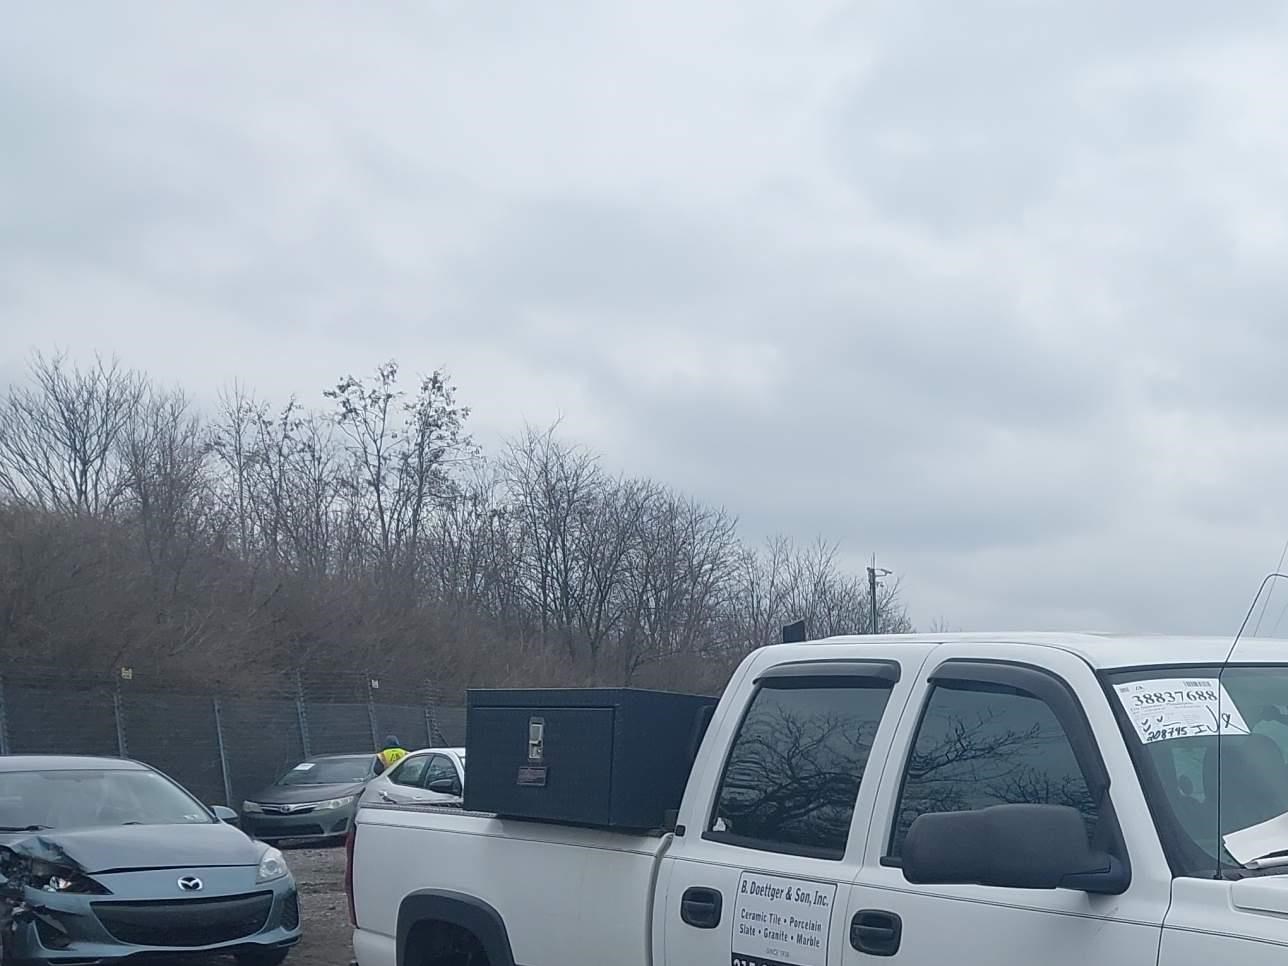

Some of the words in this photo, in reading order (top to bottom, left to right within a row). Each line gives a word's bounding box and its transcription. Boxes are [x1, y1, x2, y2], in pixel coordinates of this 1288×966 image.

[1131, 690, 1218, 706] 38837688
[741, 880, 748, 894] B.
[750, 881, 784, 901] Doettger
[785, 886, 793, 900] &
[794, 887, 812, 906] Son,
[813, 890, 829, 907] Inc.
[741, 908, 767, 922] Ceramic
[769, 913, 782, 925] Tile
[789, 917, 822, 932] Porcelain
[739, 924, 756, 936] Slate
[763, 928, 788, 942] Granite
[796, 933, 820, 948] Marble
